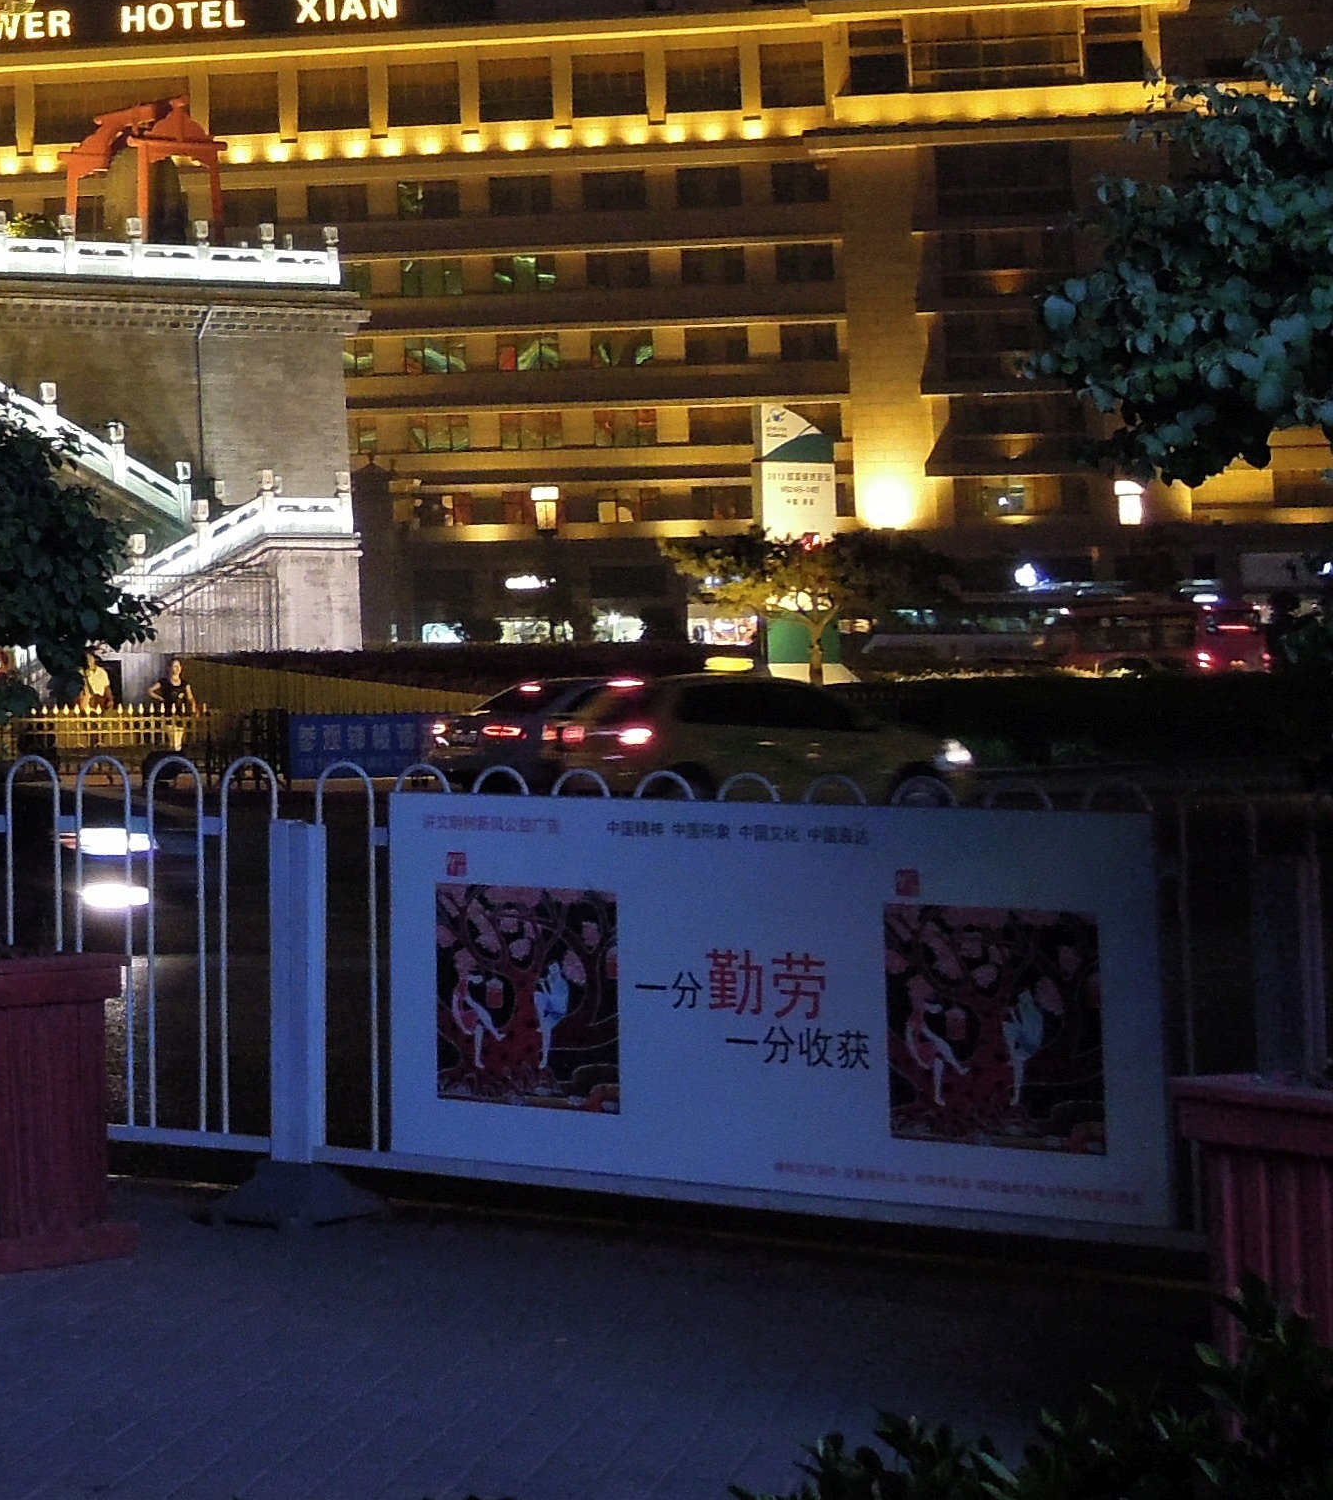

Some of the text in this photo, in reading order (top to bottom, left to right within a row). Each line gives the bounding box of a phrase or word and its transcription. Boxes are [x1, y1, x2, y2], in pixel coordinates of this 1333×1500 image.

[120, 0, 246, 34] HOTEL
[738, 823, 800, 843] 中国文化
[634, 948, 827, 1020] 一分勤劳
[725, 1026, 870, 1070] 一分收获
